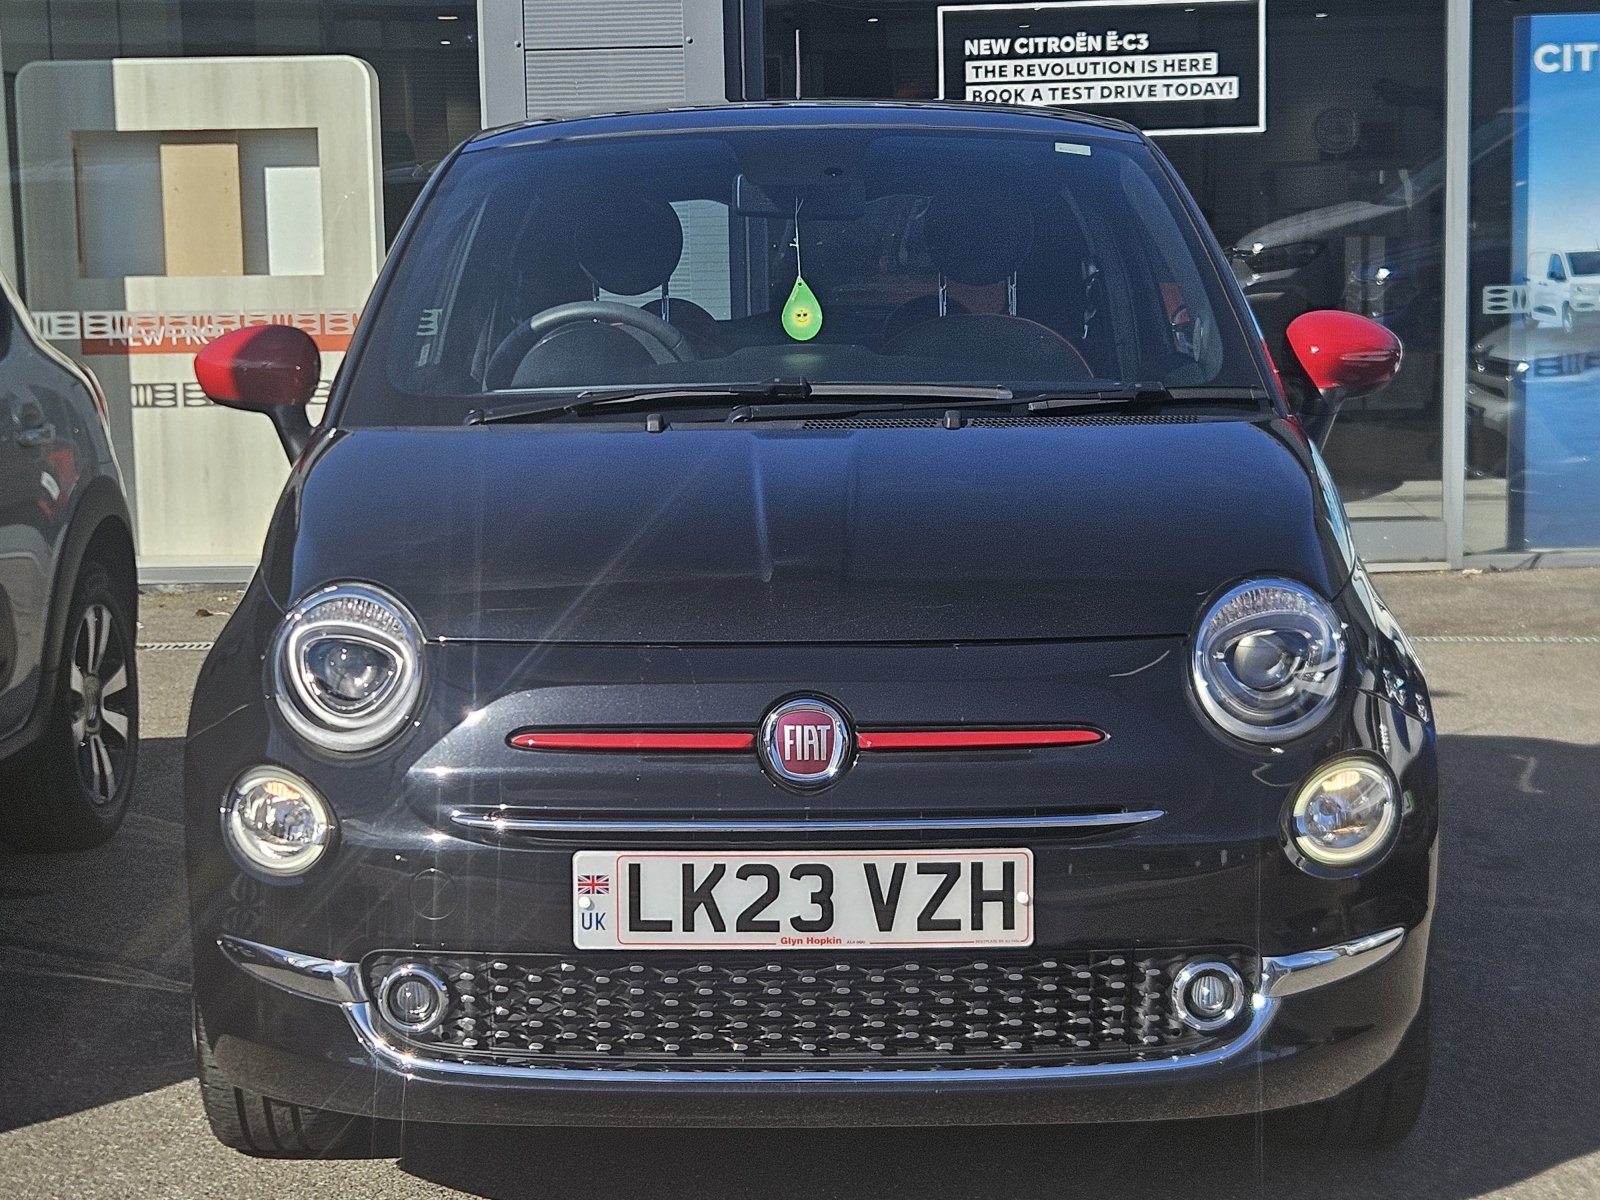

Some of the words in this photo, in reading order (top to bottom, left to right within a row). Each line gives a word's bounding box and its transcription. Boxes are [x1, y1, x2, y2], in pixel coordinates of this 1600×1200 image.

[964, 39, 1011, 56] NEW
[1013, 31, 1102, 54] CITROËN
[1105, 31, 1150, 50] Ë-C3
[972, 65, 1008, 79] THE
[1013, 60, 1136, 77] REVOLUTION
[1141, 59, 1158, 74] IS
[1163, 57, 1213, 73] HERE
[1534, 44, 1600, 72] CIT
[972, 88, 1025, 103] BOOK
[1031, 88, 1043, 102] A
[1048, 86, 1095, 101] TEST
[1100, 83, 1158, 99] DRIVE
[1162, 81, 1234, 97] TODAY!
[783, 724, 831, 761] FIAT
[628, 862, 834, 933] LK23
[863, 861, 1015, 932] VZH
[581, 912, 606, 931] UK
[780, 936, 804, 946] Glyn
[806, 936, 842, 946] Hopkin
